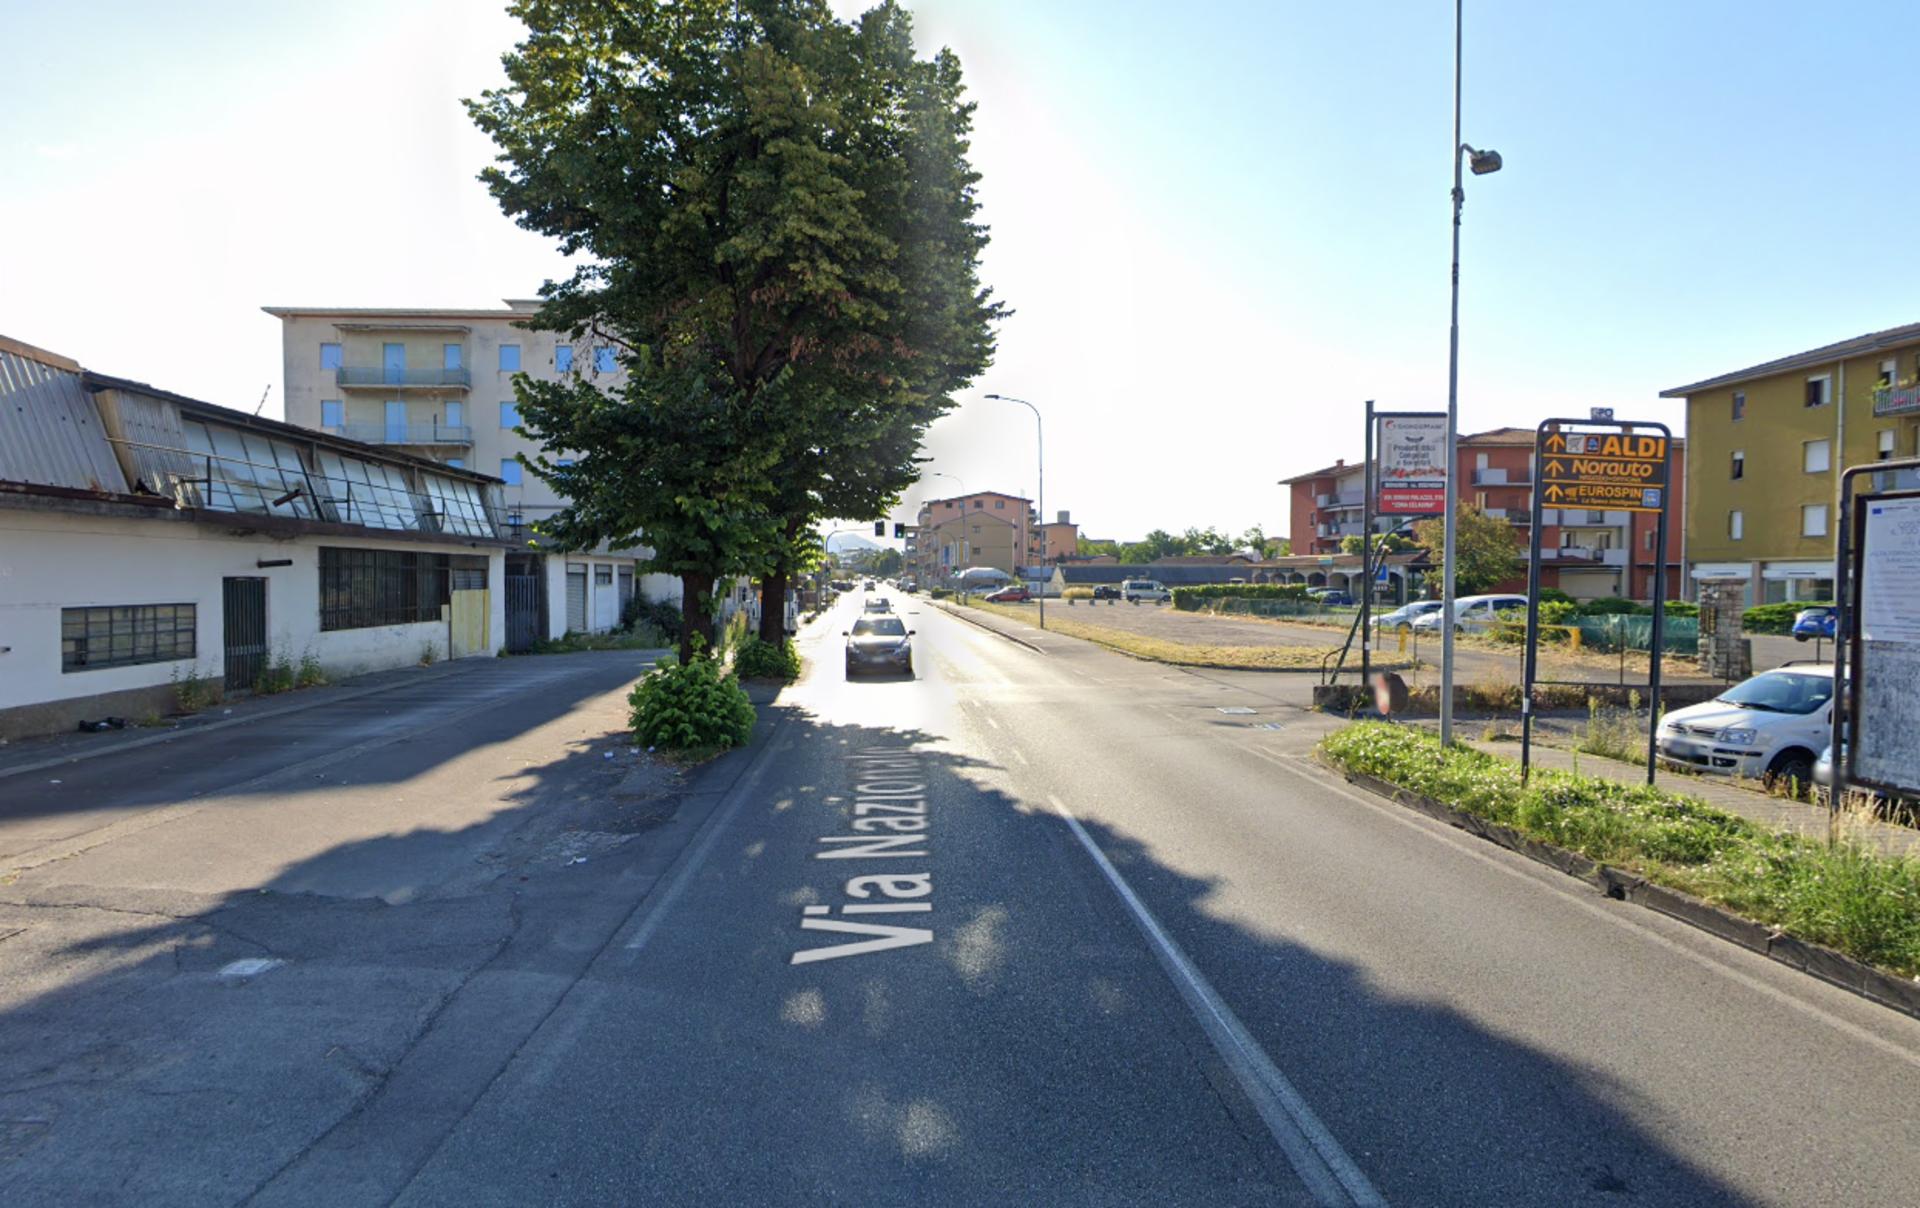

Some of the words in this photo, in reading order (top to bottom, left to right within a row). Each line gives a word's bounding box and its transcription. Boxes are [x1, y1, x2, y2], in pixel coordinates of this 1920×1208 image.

[1601, 436, 1665, 458] ALDI
[1572, 459, 1653, 478] Norauto
[1579, 485, 1642, 498] EUROSPIN
